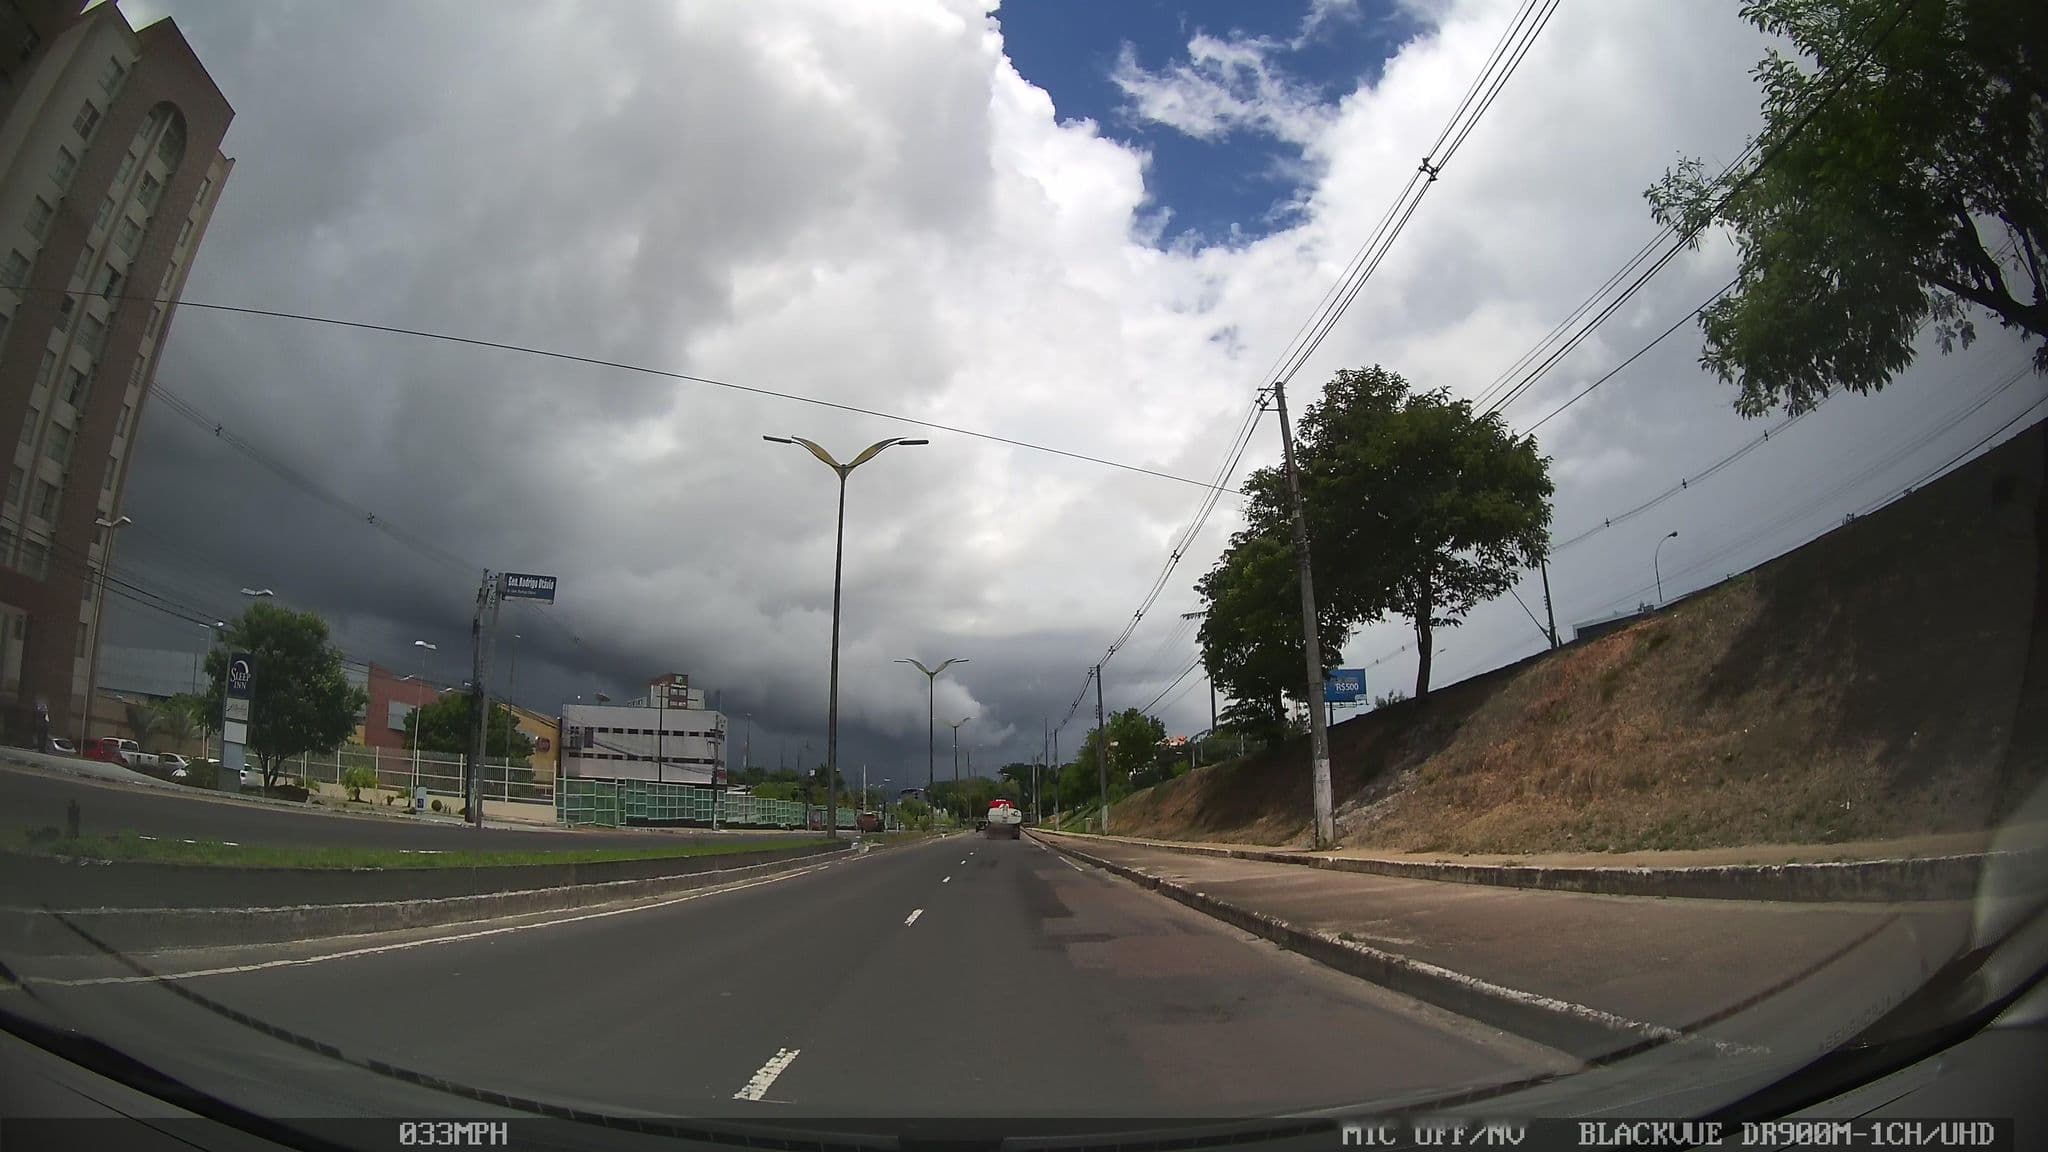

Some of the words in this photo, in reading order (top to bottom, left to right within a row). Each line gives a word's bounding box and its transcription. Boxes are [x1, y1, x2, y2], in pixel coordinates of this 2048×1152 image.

[519, 577, 538, 589] Rodrigo
[230, 667, 251, 682] SLEEP
[233, 681, 247, 689] INN
[1335, 682, 1359, 692] R$500
